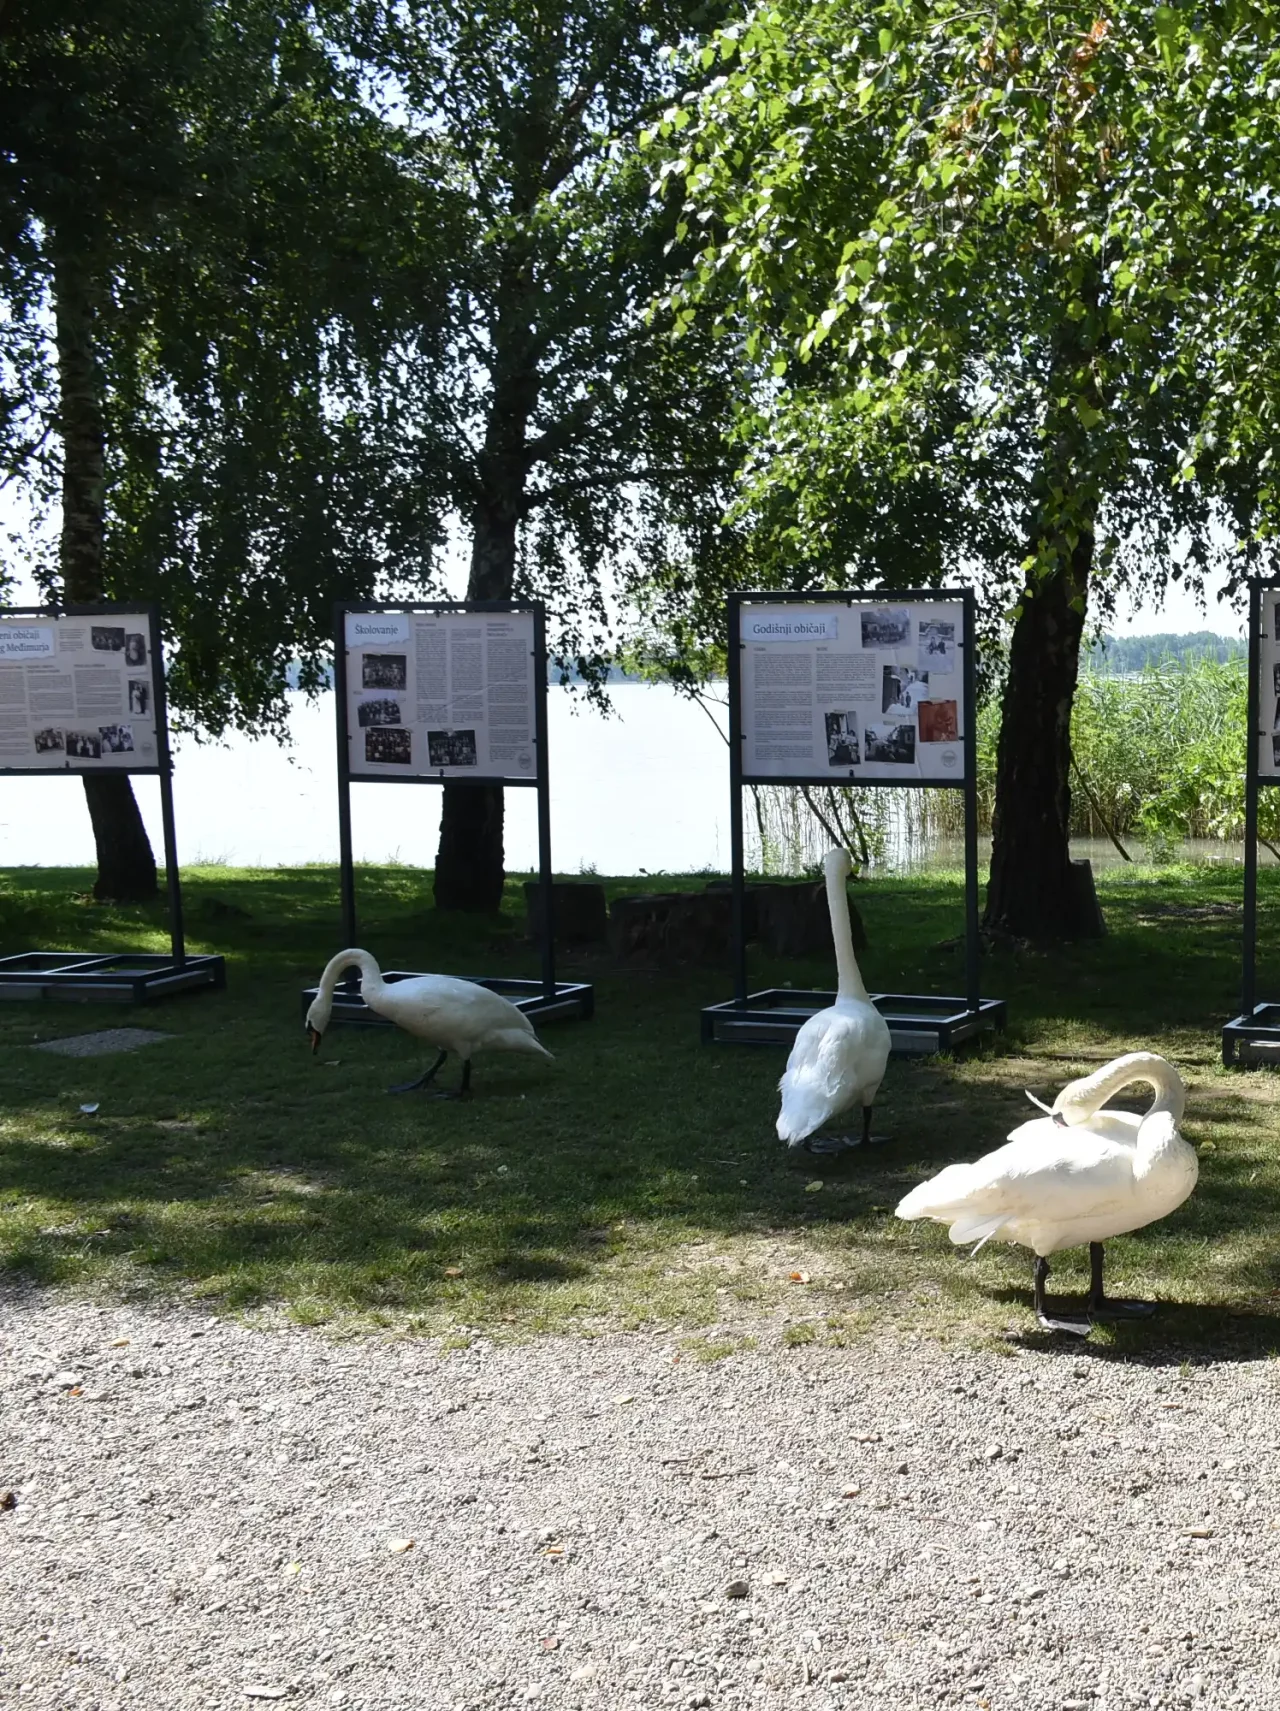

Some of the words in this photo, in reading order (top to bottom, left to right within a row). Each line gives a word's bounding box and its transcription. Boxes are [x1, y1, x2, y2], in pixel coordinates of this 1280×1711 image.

[355, 624, 399, 636] Školovanje
[753, 623, 792, 635] Godišnji
[794, 622, 826, 635] običaji
[13, 630, 40, 640] običaji
